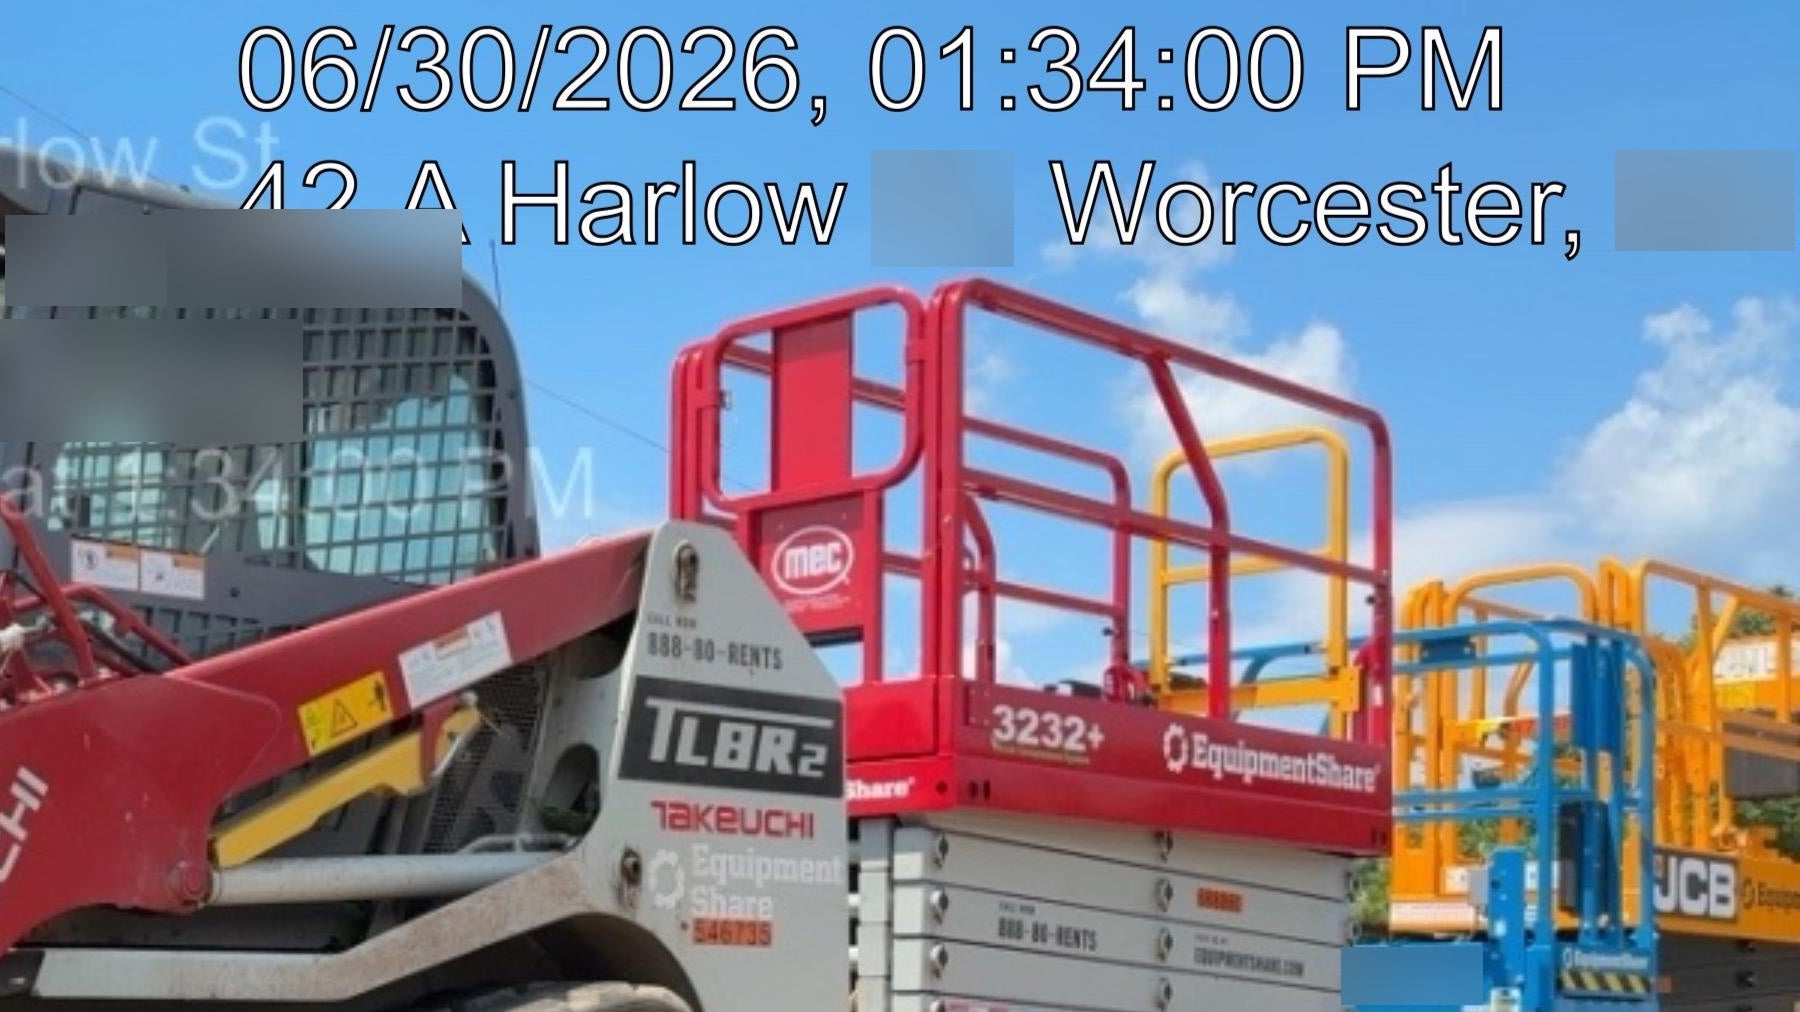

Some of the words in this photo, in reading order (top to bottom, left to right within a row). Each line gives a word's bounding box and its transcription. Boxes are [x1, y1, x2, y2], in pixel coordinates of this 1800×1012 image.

[991, 704, 1104, 751] 3232+
[1192, 732, 1377, 792] EquipmentShare
[691, 843, 842, 887] Equipment
[1653, 854, 1736, 919] JCB
[691, 884, 774, 920] Share
